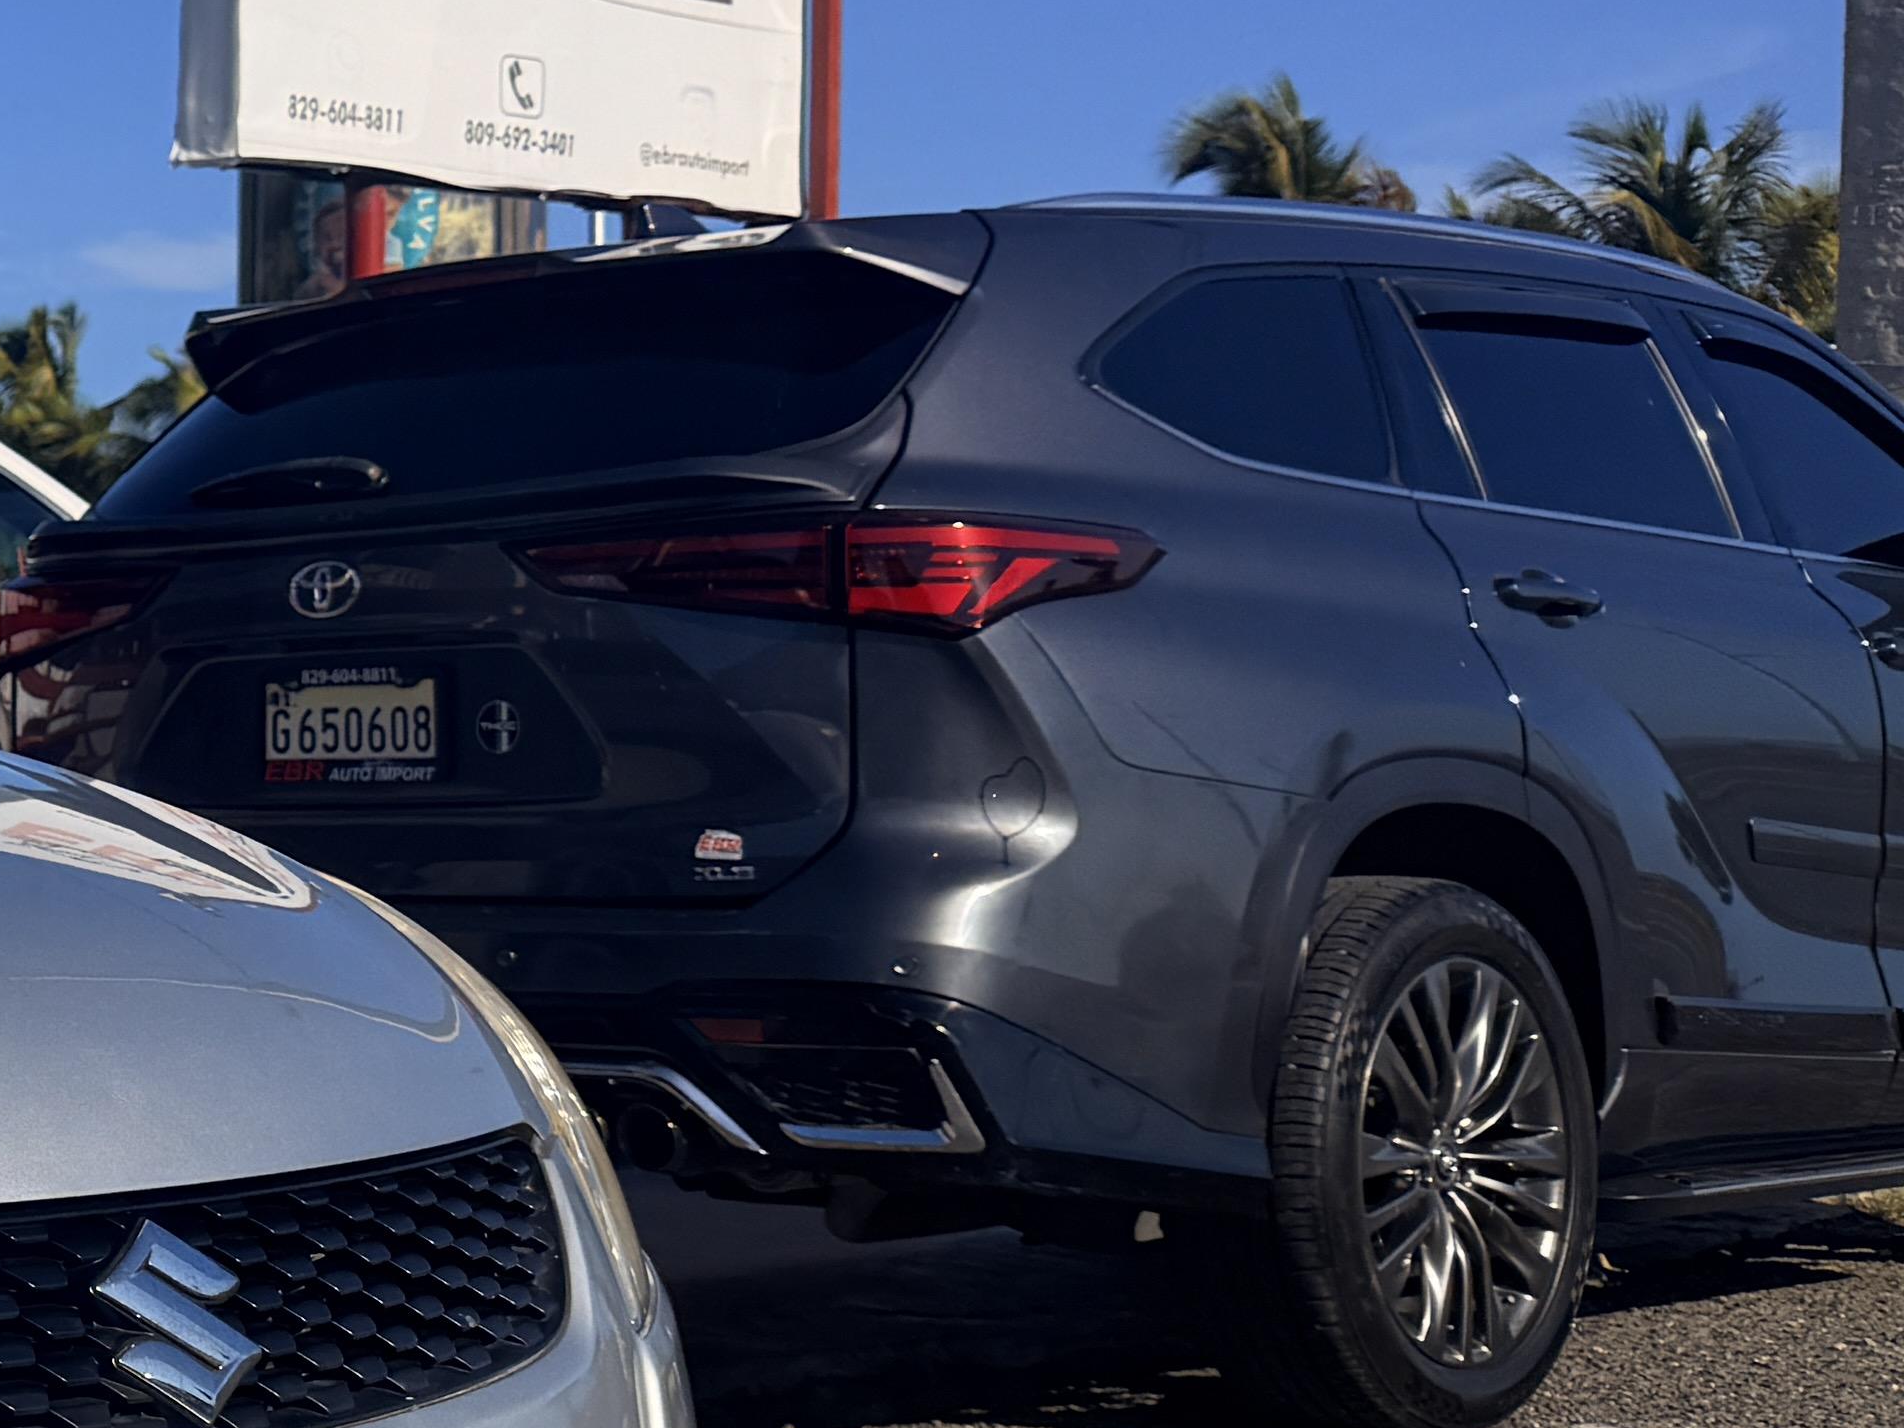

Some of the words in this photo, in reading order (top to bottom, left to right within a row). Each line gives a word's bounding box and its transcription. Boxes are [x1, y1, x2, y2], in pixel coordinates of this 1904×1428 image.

[288, 93, 403, 134] 829-604-8811
[464, 119, 575, 158] 809-692-3401
[639, 141, 750, 179] @ebrautoimport
[300, 667, 396, 685] 829-604-8811
[272, 705, 431, 754] G650608
[264, 761, 325, 782] EBR
[328, 766, 374, 783] AUTO
[374, 765, 436, 782] IMPORT
